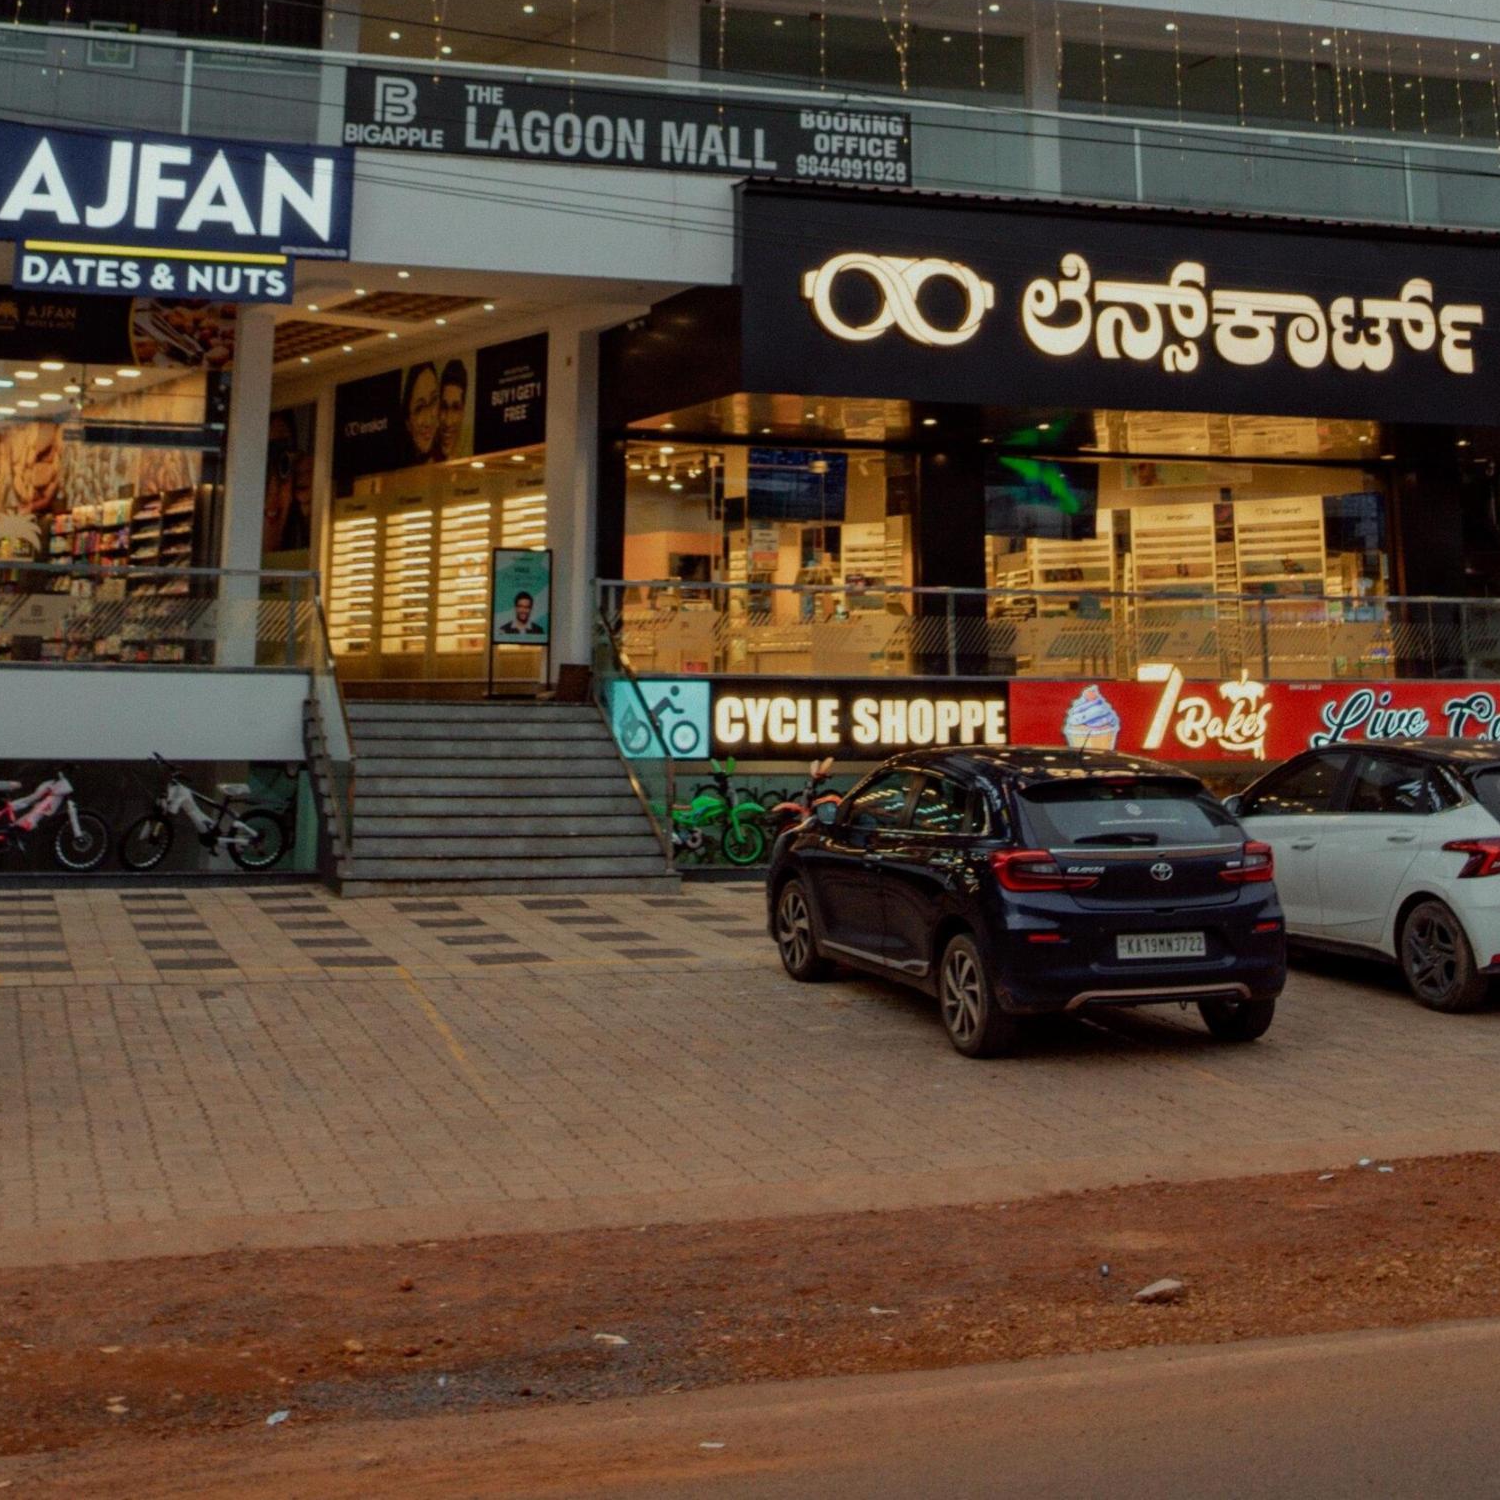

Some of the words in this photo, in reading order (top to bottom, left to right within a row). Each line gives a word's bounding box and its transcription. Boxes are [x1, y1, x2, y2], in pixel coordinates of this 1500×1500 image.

[464, 83, 504, 106] THE
[343, 122, 444, 150] BIGAPPLE
[463, 105, 646, 163] LAGOON
[660, 120, 778, 171] MALL
[799, 109, 903, 137] BOOKING
[813, 132, 898, 159] OFFICE
[795, 154, 908, 183] 9844991928
[20, 254, 142, 290] DATES
[149, 262, 176, 292] &
[187, 265, 287, 297] NUTS
[713, 693, 841, 746] CYCLE
[849, 696, 1006, 746] SHOPPE
[1174, 694, 1273, 752] Bakes
[1309, 688, 1431, 749] Live
